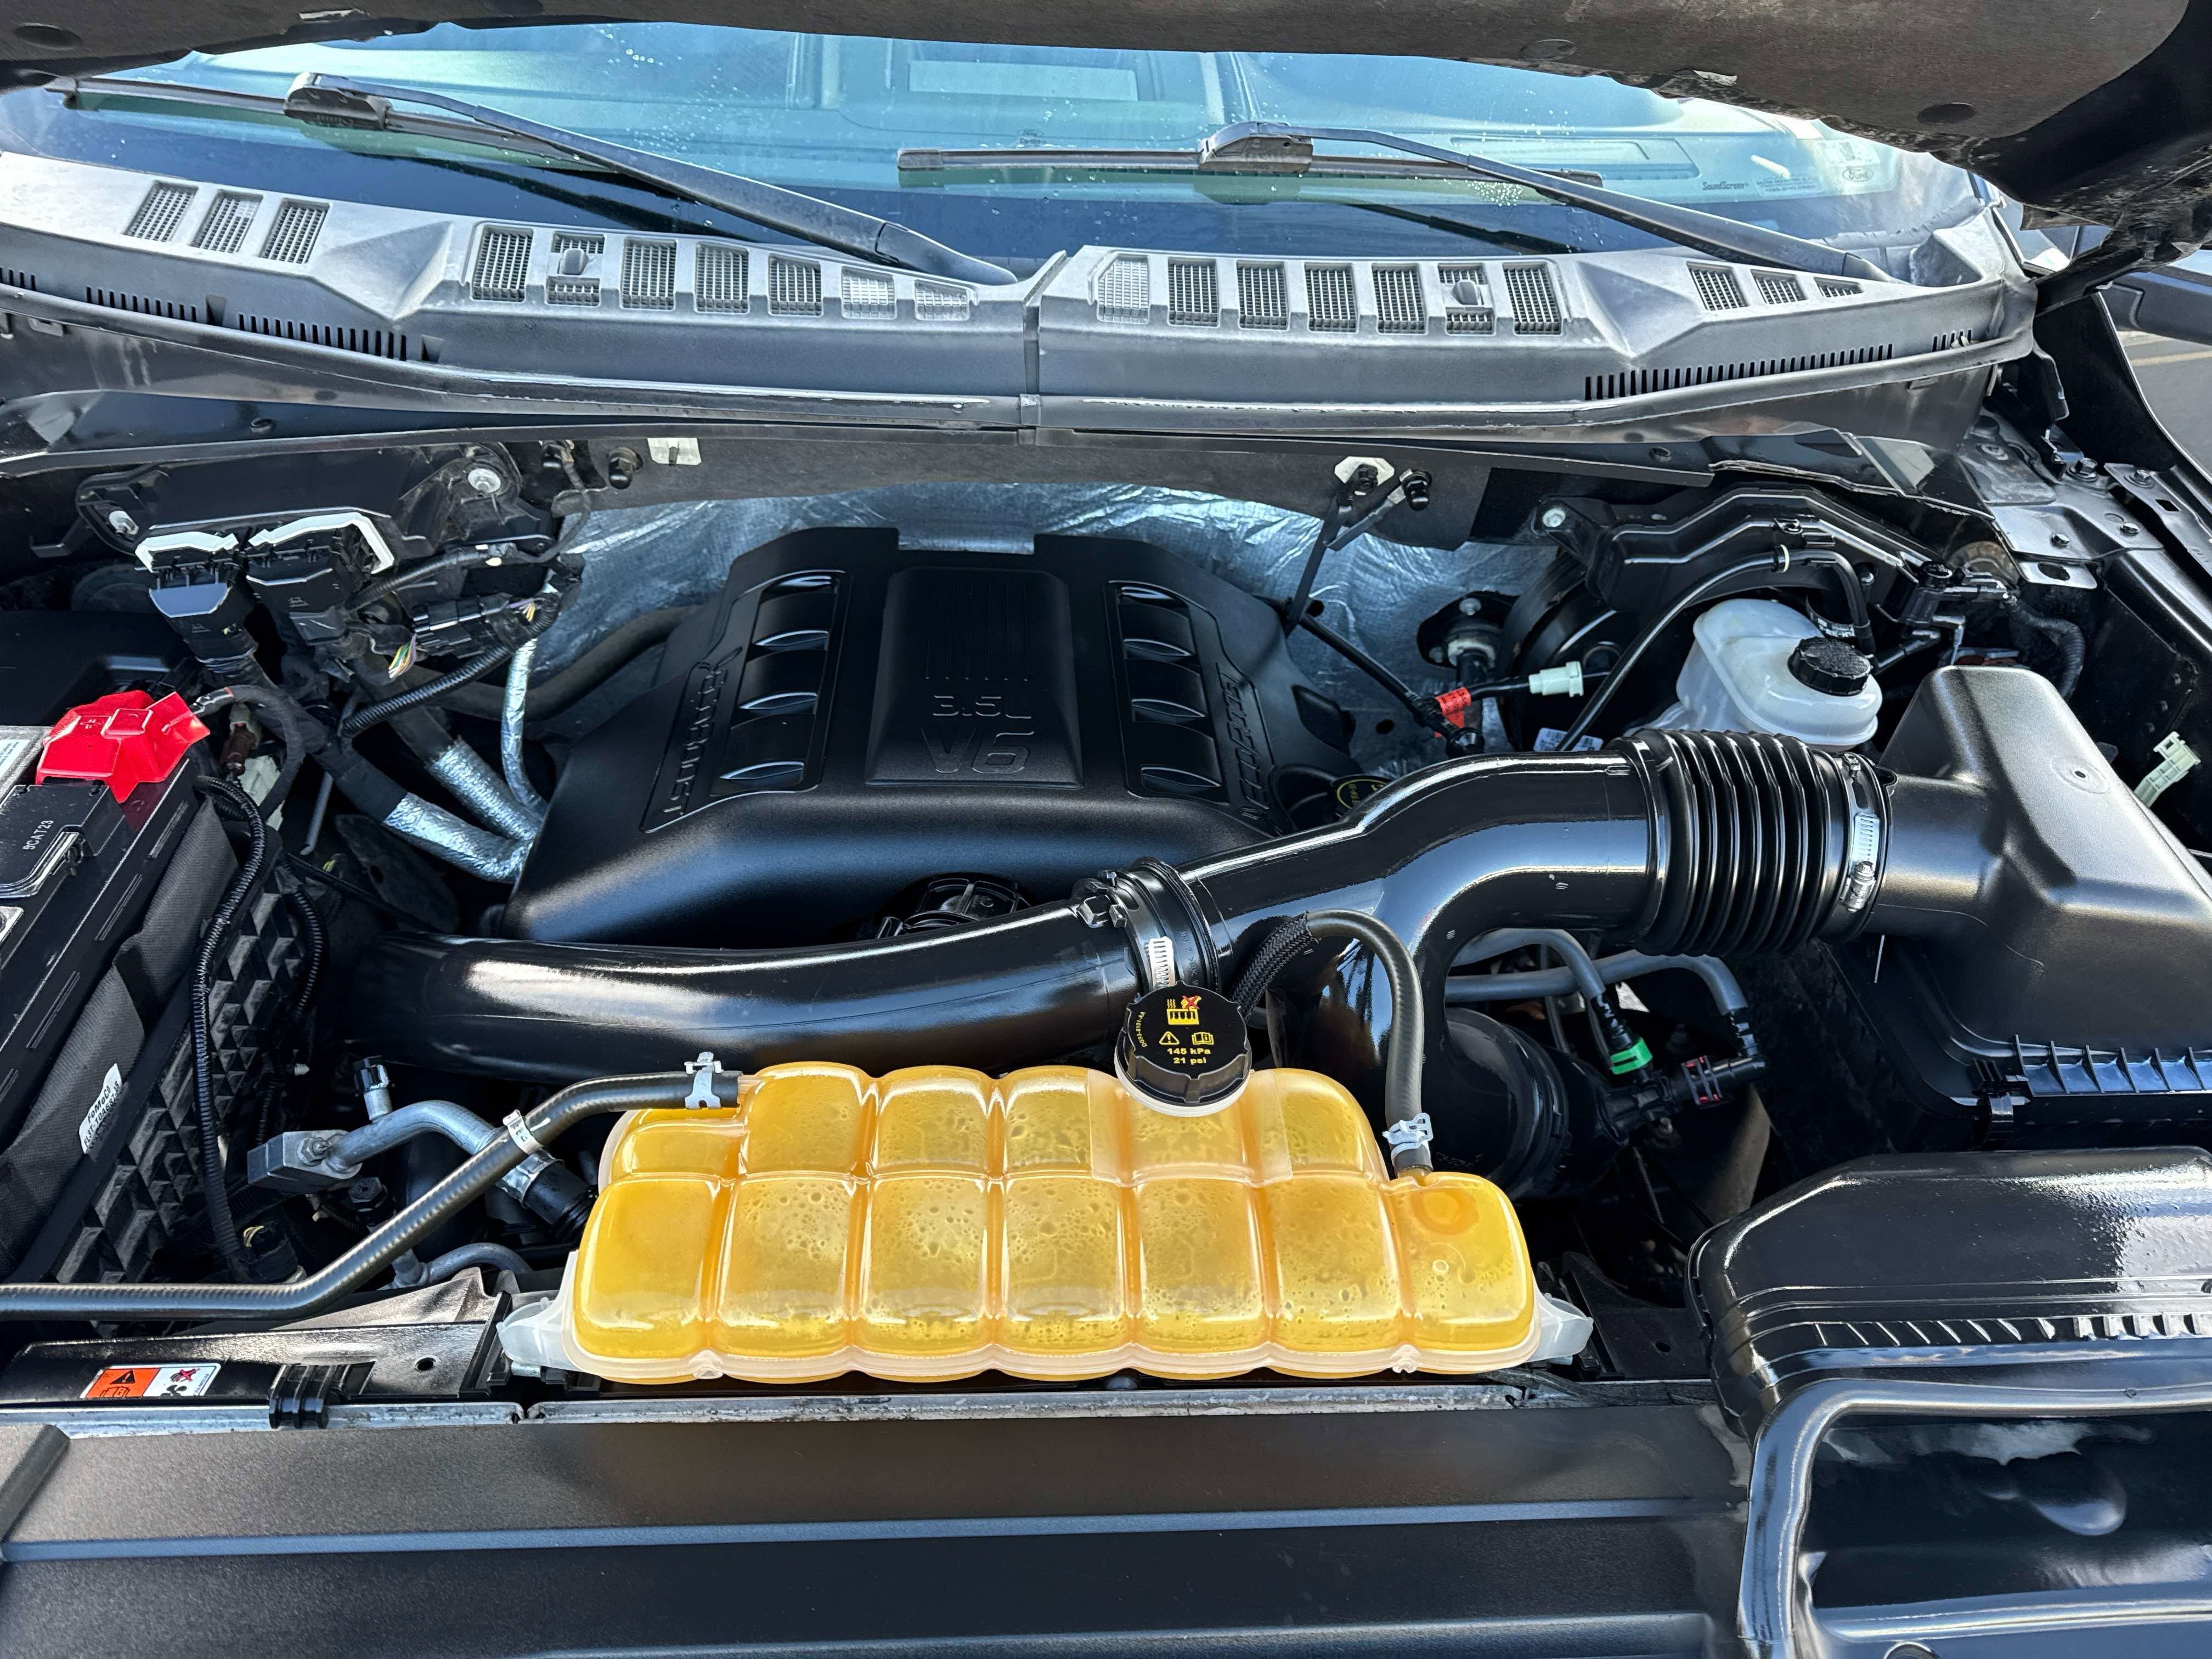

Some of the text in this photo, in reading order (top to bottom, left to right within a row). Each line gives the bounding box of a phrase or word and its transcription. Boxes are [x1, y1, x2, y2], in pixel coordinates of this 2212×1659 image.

[933, 695, 1032, 719] 3.5L
[921, 726, 1034, 775] V6
[1190, 1057, 1207, 1065] psi
[87, 1085, 111, 1124] FoMoCo
